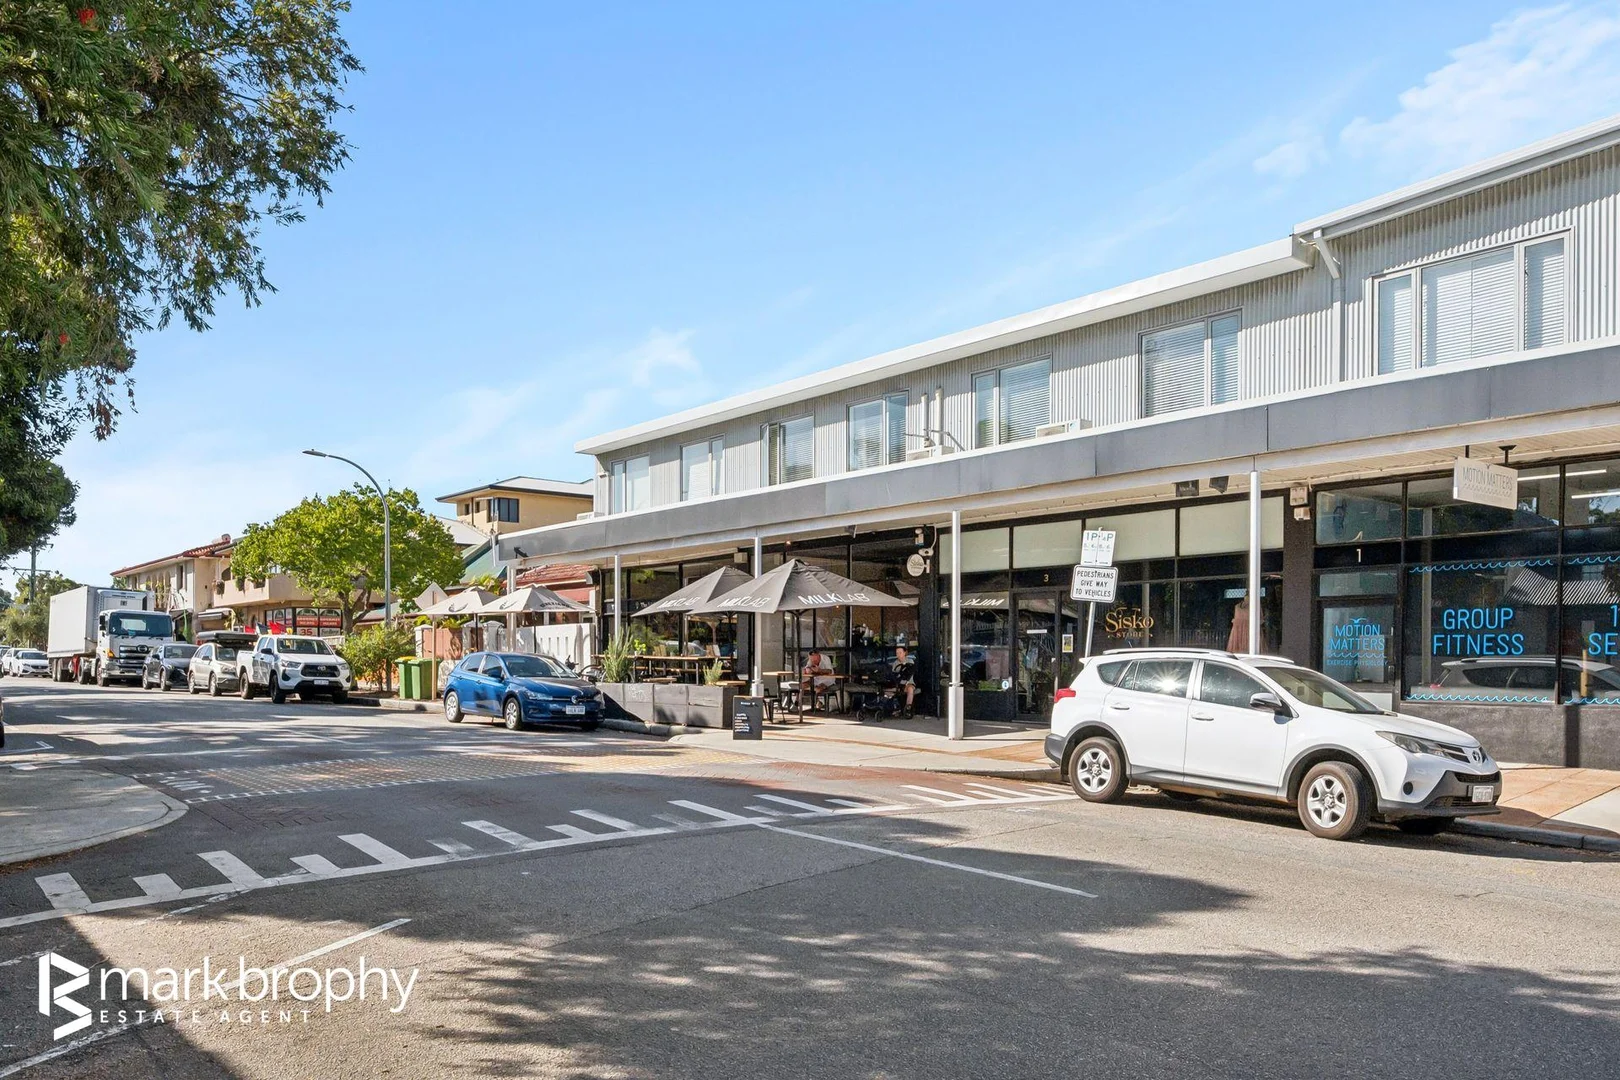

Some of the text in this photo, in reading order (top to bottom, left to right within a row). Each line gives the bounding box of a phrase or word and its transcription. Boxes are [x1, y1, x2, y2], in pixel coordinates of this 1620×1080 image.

[1462, 466, 1513, 491] MOTION MATTERS
[1356, 548, 1362, 563] 1
[1043, 574, 1049, 582] 3
[1076, 570, 1115, 580] PEDESTRIANS
[1080, 579, 1109, 588] GIVE WAY
[797, 592, 871, 606] MILKLAB
[1084, 589, 1112, 598] VEHICLES
[717, 595, 772, 608] MILKLAB
[1105, 607, 1154, 632] Sisko
[1443, 607, 1514, 630] GROUP
[300, 628, 313, 636] 35
[1335, 624, 1381, 637] MOTION
[1329, 637, 1385, 651] MATTERS
[1433, 633, 1525, 656] FITNESS
